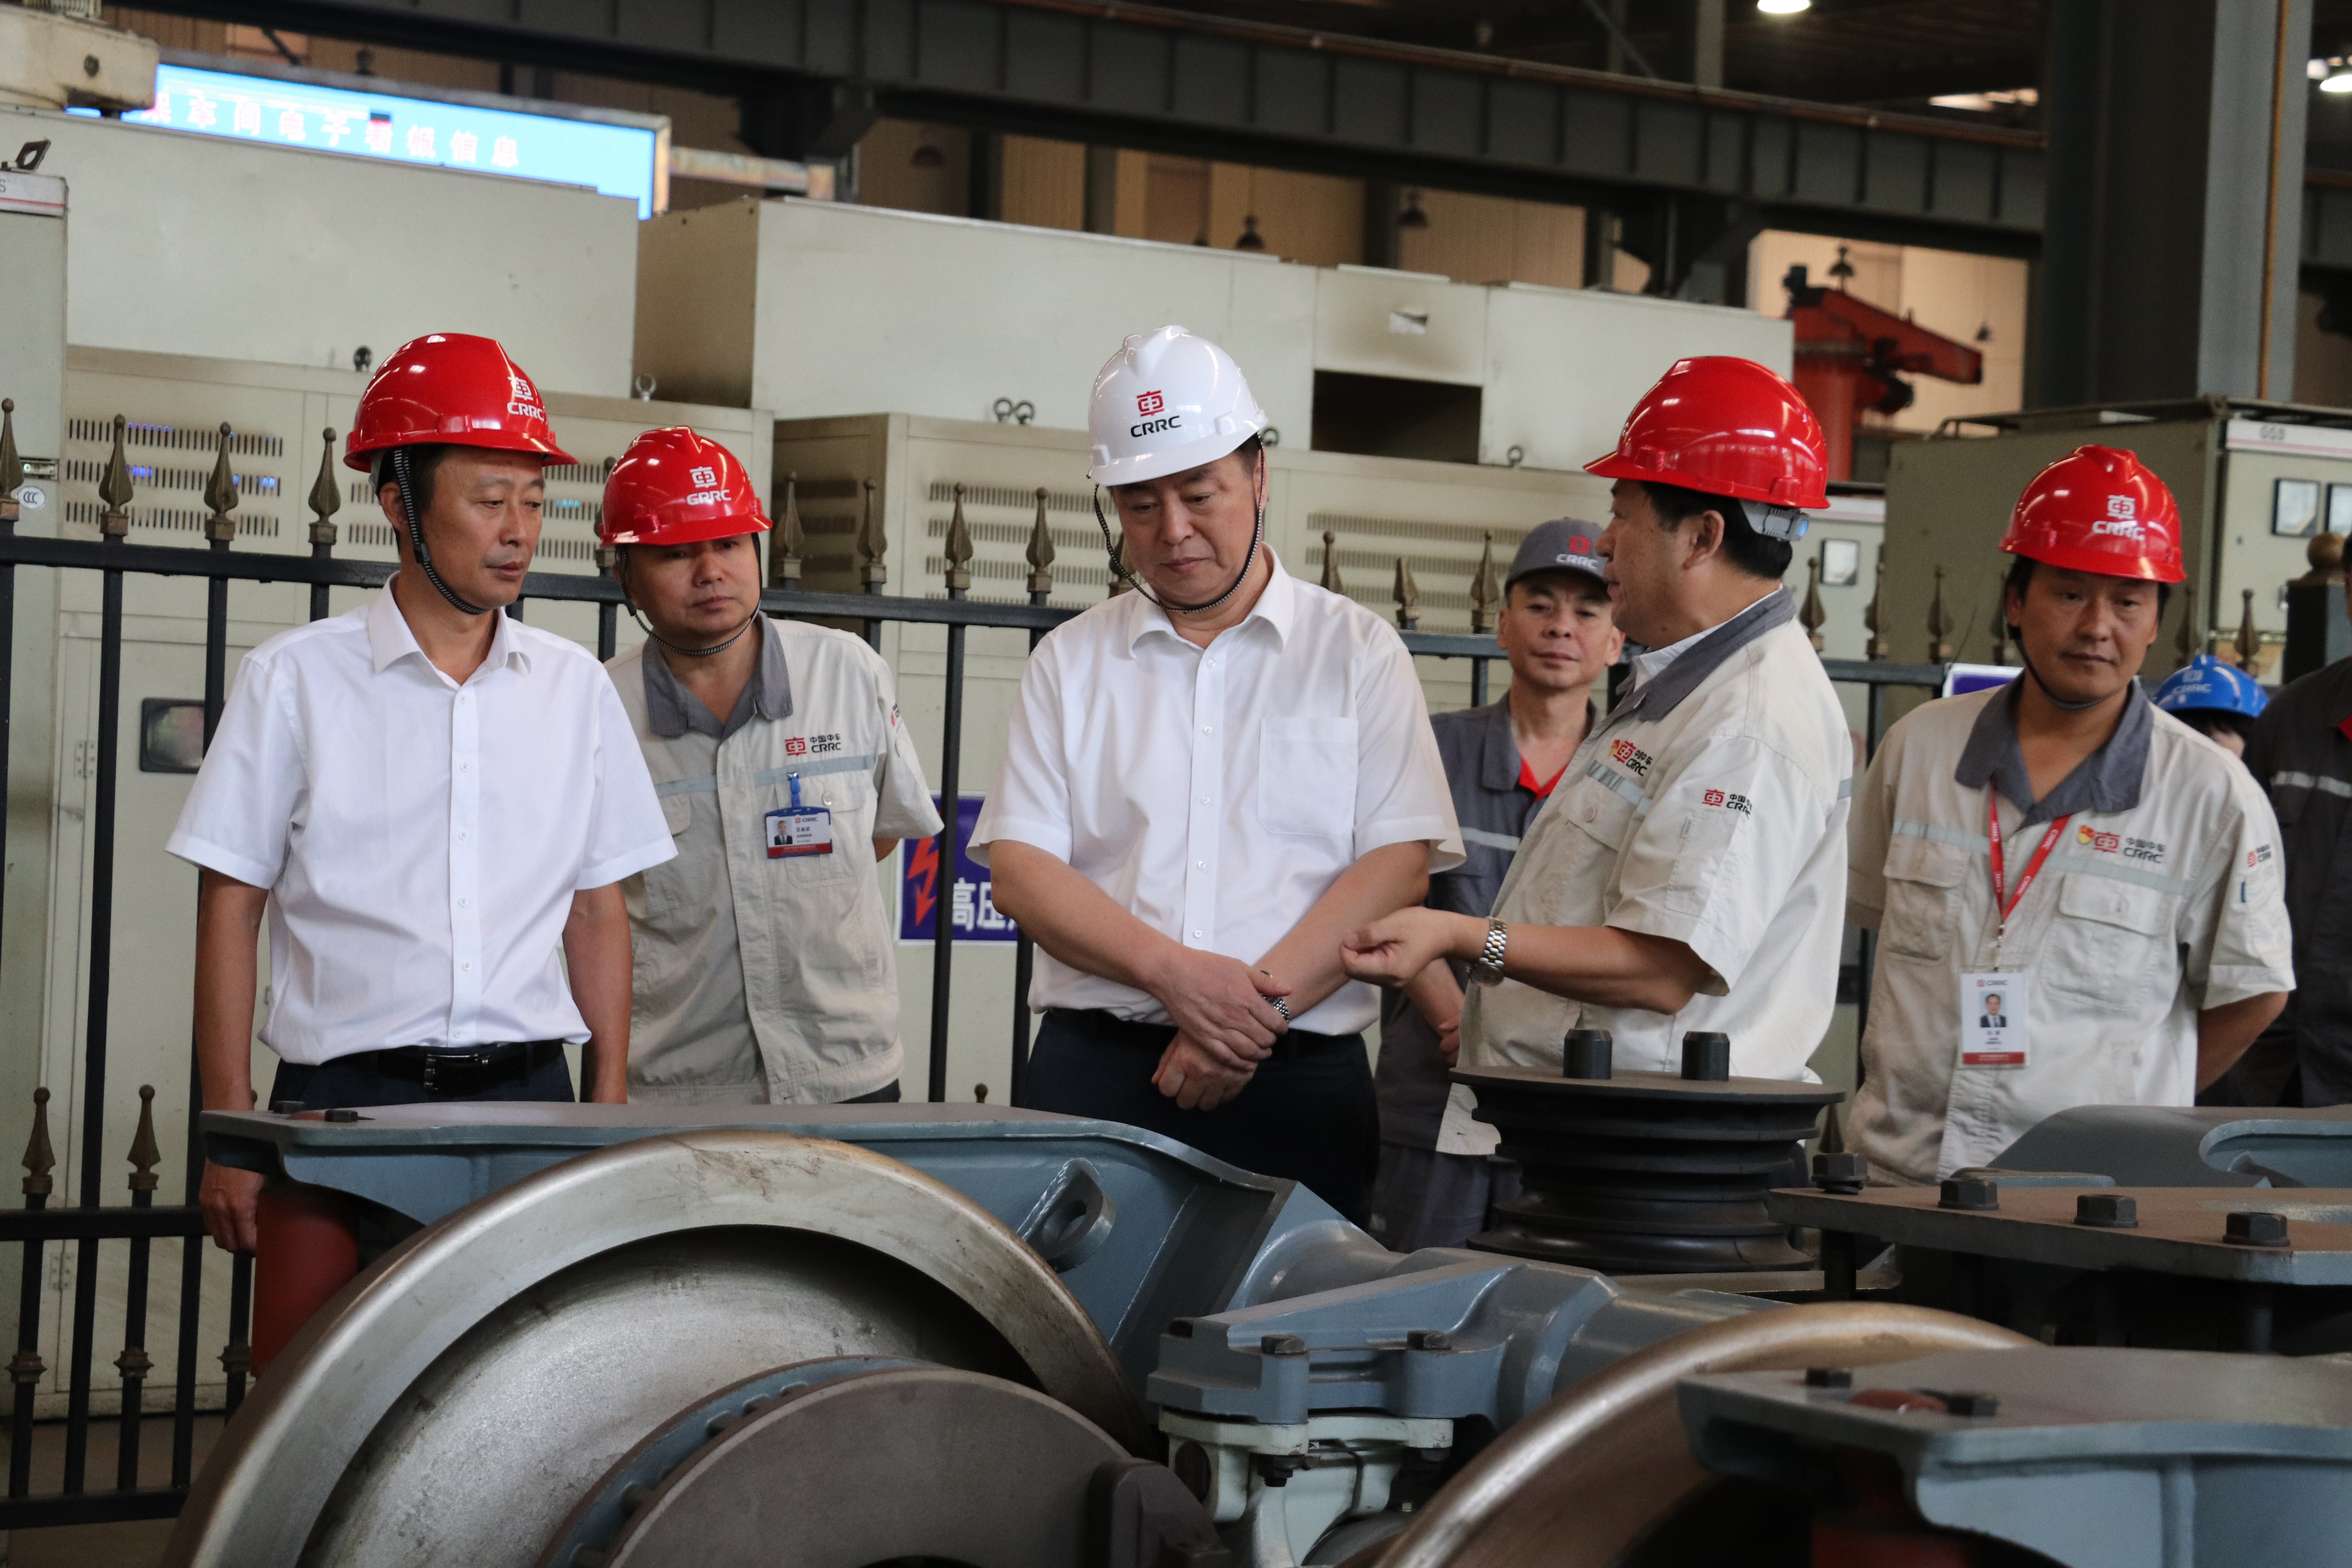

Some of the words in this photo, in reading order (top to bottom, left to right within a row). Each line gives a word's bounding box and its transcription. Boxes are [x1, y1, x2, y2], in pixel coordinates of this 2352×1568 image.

[507, 401, 544, 422] CRRC
[1131, 415, 1181, 437] CRRC
[686, 489, 732, 506] CRRC
[2092, 520, 2146, 541] CRRC
[1555, 554, 1599, 569] CRRC
[810, 734, 840, 743] 中国中车
[811, 742, 841, 753] CRRC
[2123, 847, 2163, 863] CRRC
[953, 877, 1017, 932] 高压
